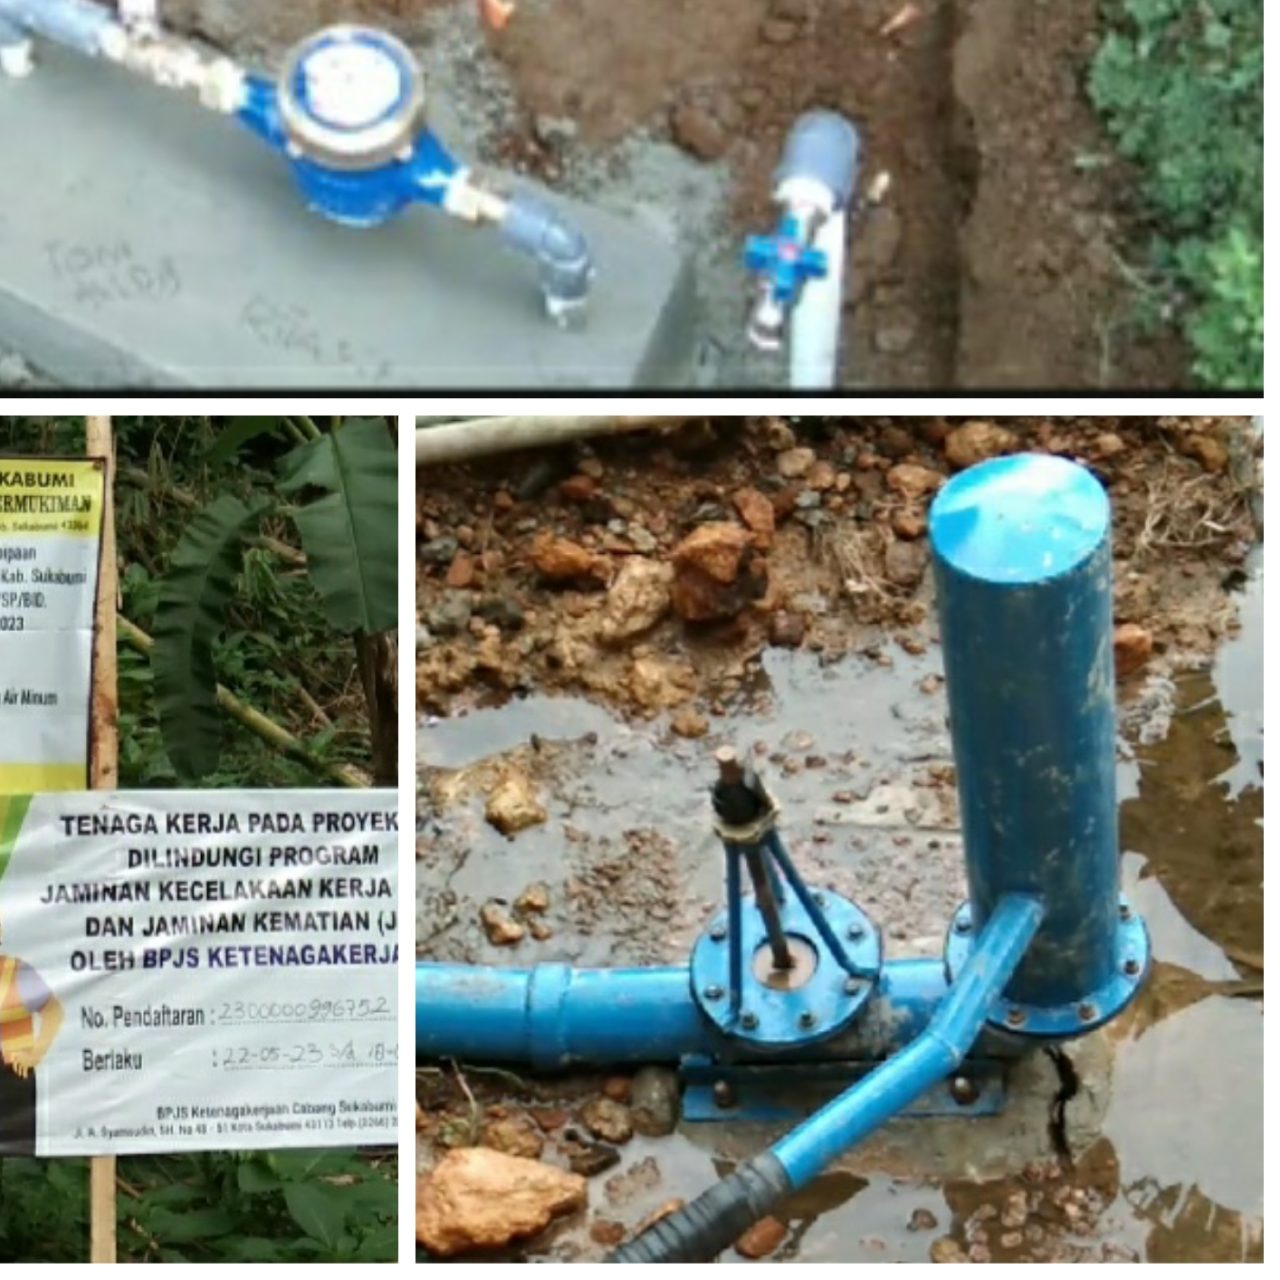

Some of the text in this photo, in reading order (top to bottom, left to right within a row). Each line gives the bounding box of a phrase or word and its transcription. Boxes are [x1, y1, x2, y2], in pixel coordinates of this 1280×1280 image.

[0, 569, 27, 584] Kab.
[31, 569, 87, 586] Sukabumi
[4, 688, 18, 704] Air
[21, 689, 58, 705] Minum
[60, 812, 398, 836] TENAGA KERJA PADA PROYEK
[128, 845, 379, 869] DILINDUNGI PROGRAM
[40, 877, 392, 905] JAMINAN KECELAKAAN KERJA
[86, 916, 134, 938] DAN
[143, 913, 246, 936] JAMINAN
[253, 910, 370, 933] KEMATIAN
[71, 949, 135, 972] OLEH
[143, 946, 200, 970] BPJS
[81, 1006, 108, 1029] No.
[113, 1005, 205, 1028] Pendaftaran
[82, 1049, 143, 1071] Berlaku
[156, 1099, 397, 1121] BPJS Ketenagakerjaan Cabang Sukabumi
